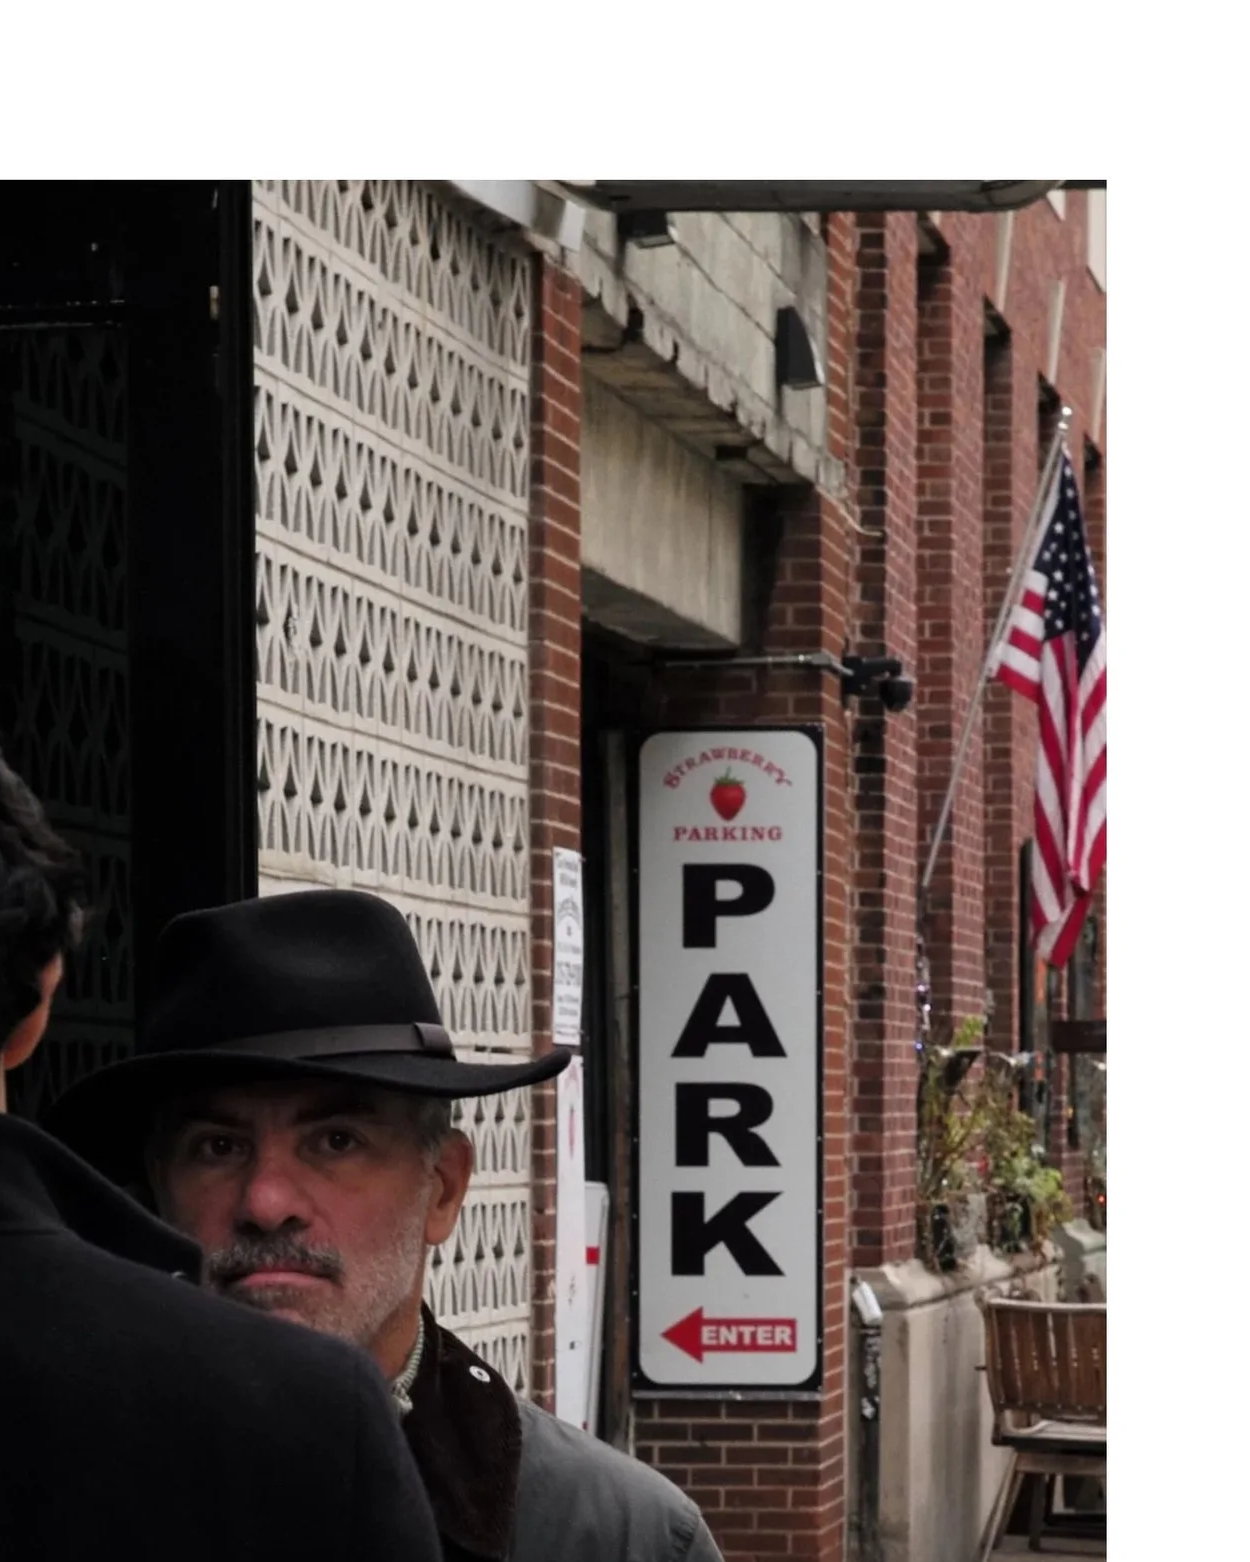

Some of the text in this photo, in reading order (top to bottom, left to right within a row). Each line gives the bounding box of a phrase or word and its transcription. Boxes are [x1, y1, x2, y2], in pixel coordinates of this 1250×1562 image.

[662, 747, 793, 790] STRAWBERRY
[672, 825, 784, 843] PARKING
[670, 863, 787, 1277] PARK
[701, 1324, 793, 1347] ENTER
